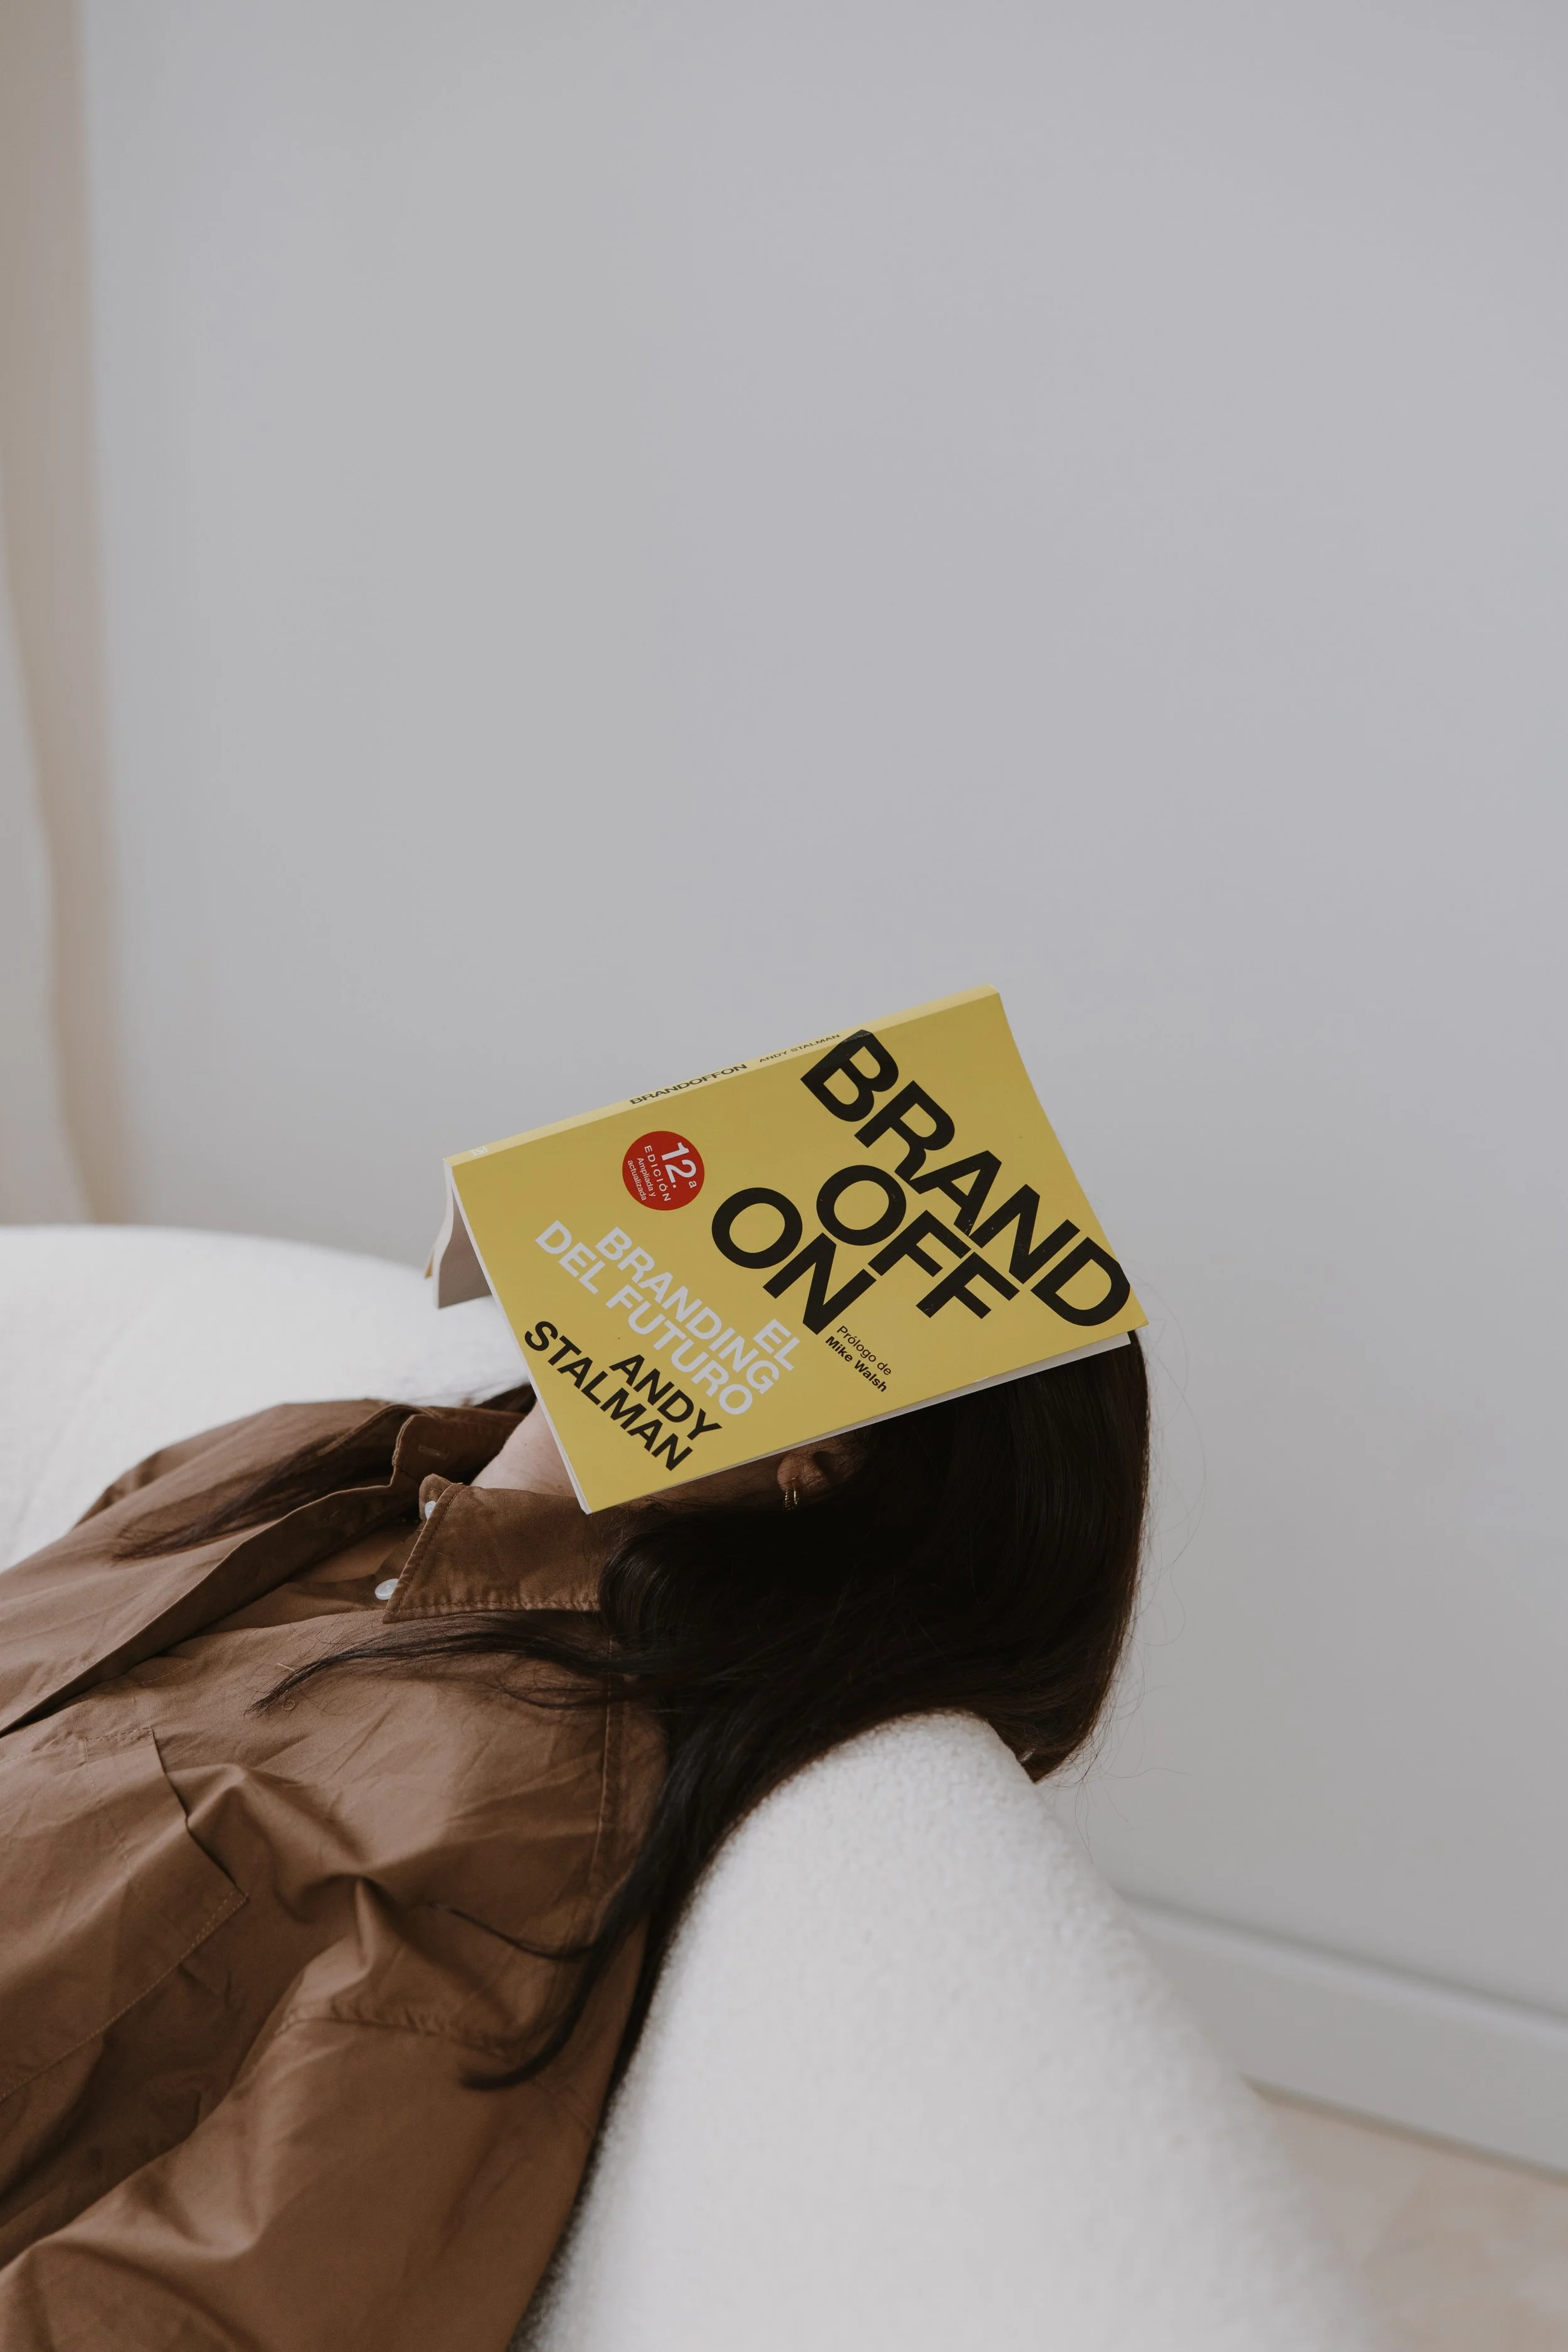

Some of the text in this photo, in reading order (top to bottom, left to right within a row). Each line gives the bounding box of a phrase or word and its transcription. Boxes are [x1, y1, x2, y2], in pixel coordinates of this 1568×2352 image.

[759, 1034, 840, 1062] ANDY STALMAN
[629, 1064, 747, 1104] BRANDOFFON
[627, 1160, 647, 1201] actualizada
[637, 1158, 654, 1192] Ampliada
[644, 1145, 671, 1202] EDICIÓN
[800, 1029, 1131, 1327] BRAND
[711, 1187, 877, 1335] ON
[816, 1165, 1020, 1319] OFF
[535, 1220, 753, 1415] DEL FUTURO
[595, 1226, 780, 1394] BRANDING
[753, 1318, 800, 1371] EL
[825, 1336, 887, 1392] Mike Walsh
[837, 1325, 891, 1375] Prólogo de
[524, 1321, 693, 1471] STALMAN
[608, 1354, 723, 1441] ANDY
